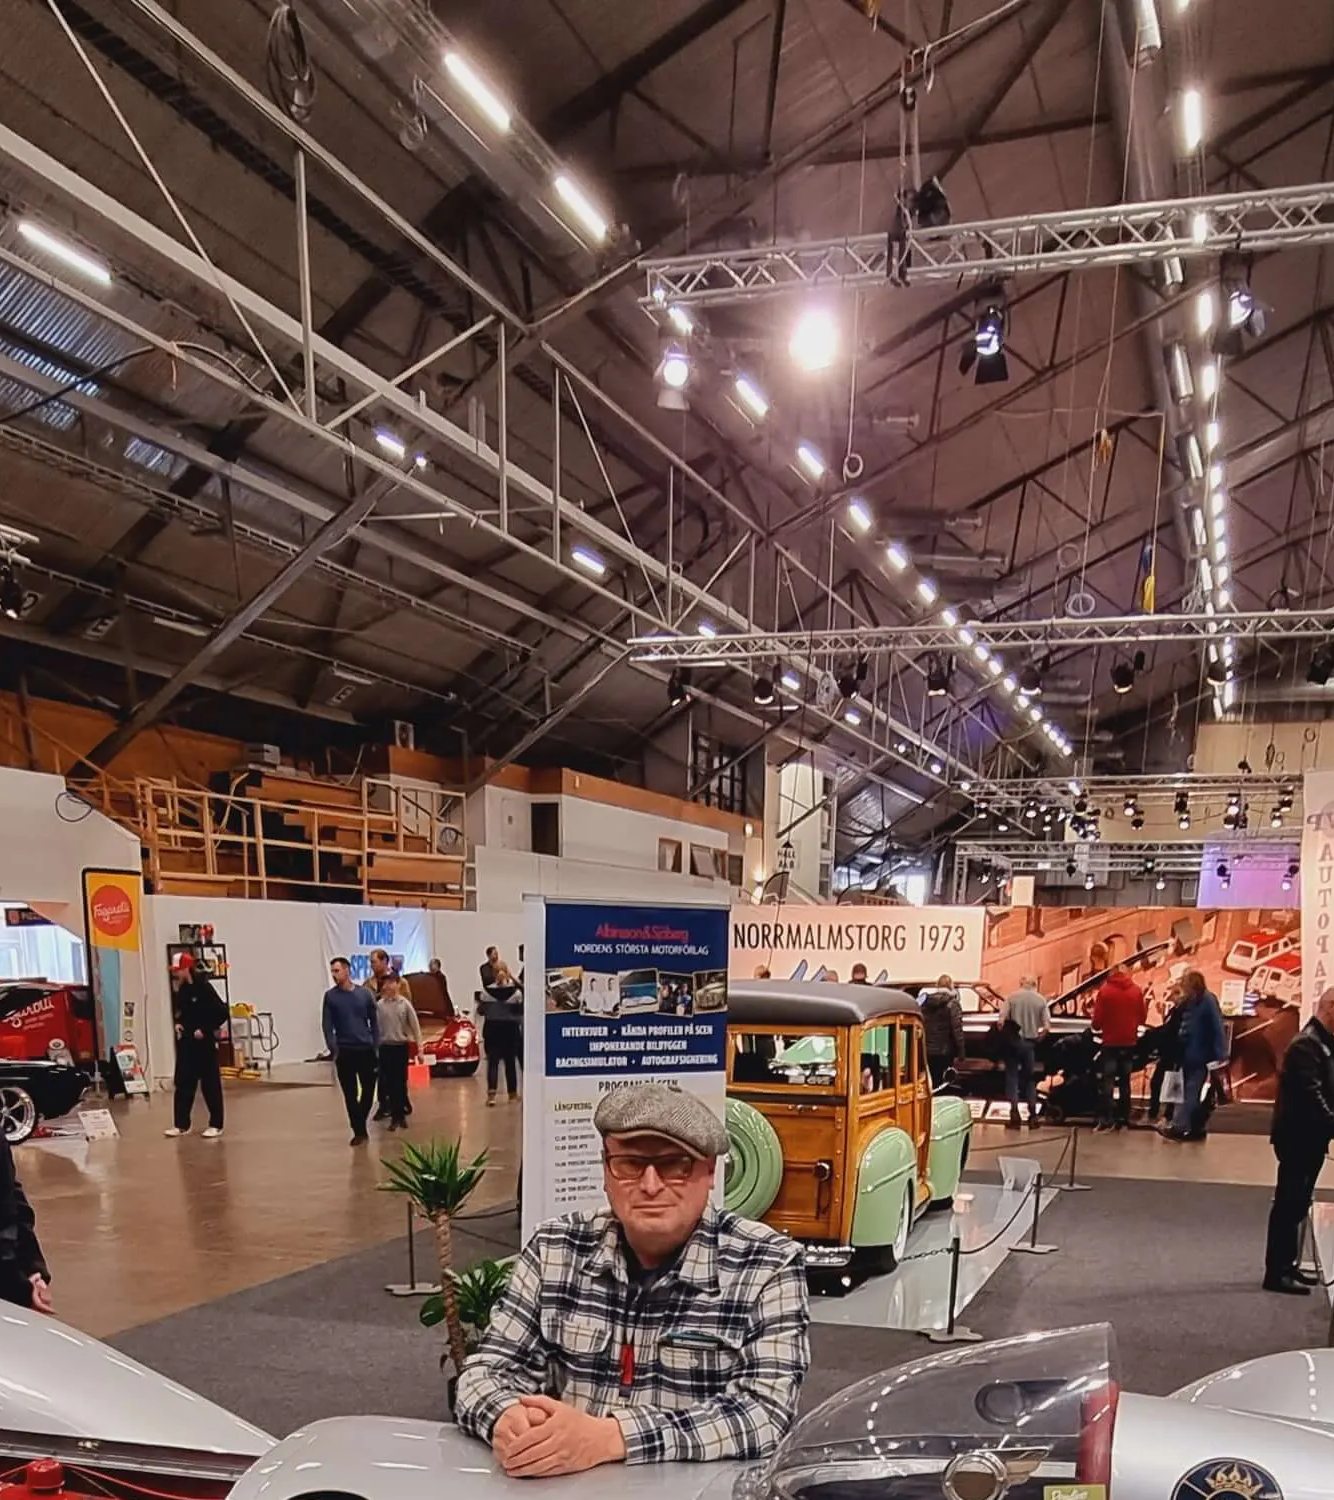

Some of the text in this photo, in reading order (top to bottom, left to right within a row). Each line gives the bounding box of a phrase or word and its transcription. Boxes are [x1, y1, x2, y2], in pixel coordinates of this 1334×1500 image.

[358, 920, 394, 945] VIKING
[733, 922, 966, 951] NORRMALMSTORG 1973
[573, 943, 613, 954] NORDENS
[616, 942, 649, 954] STÖRSTA
